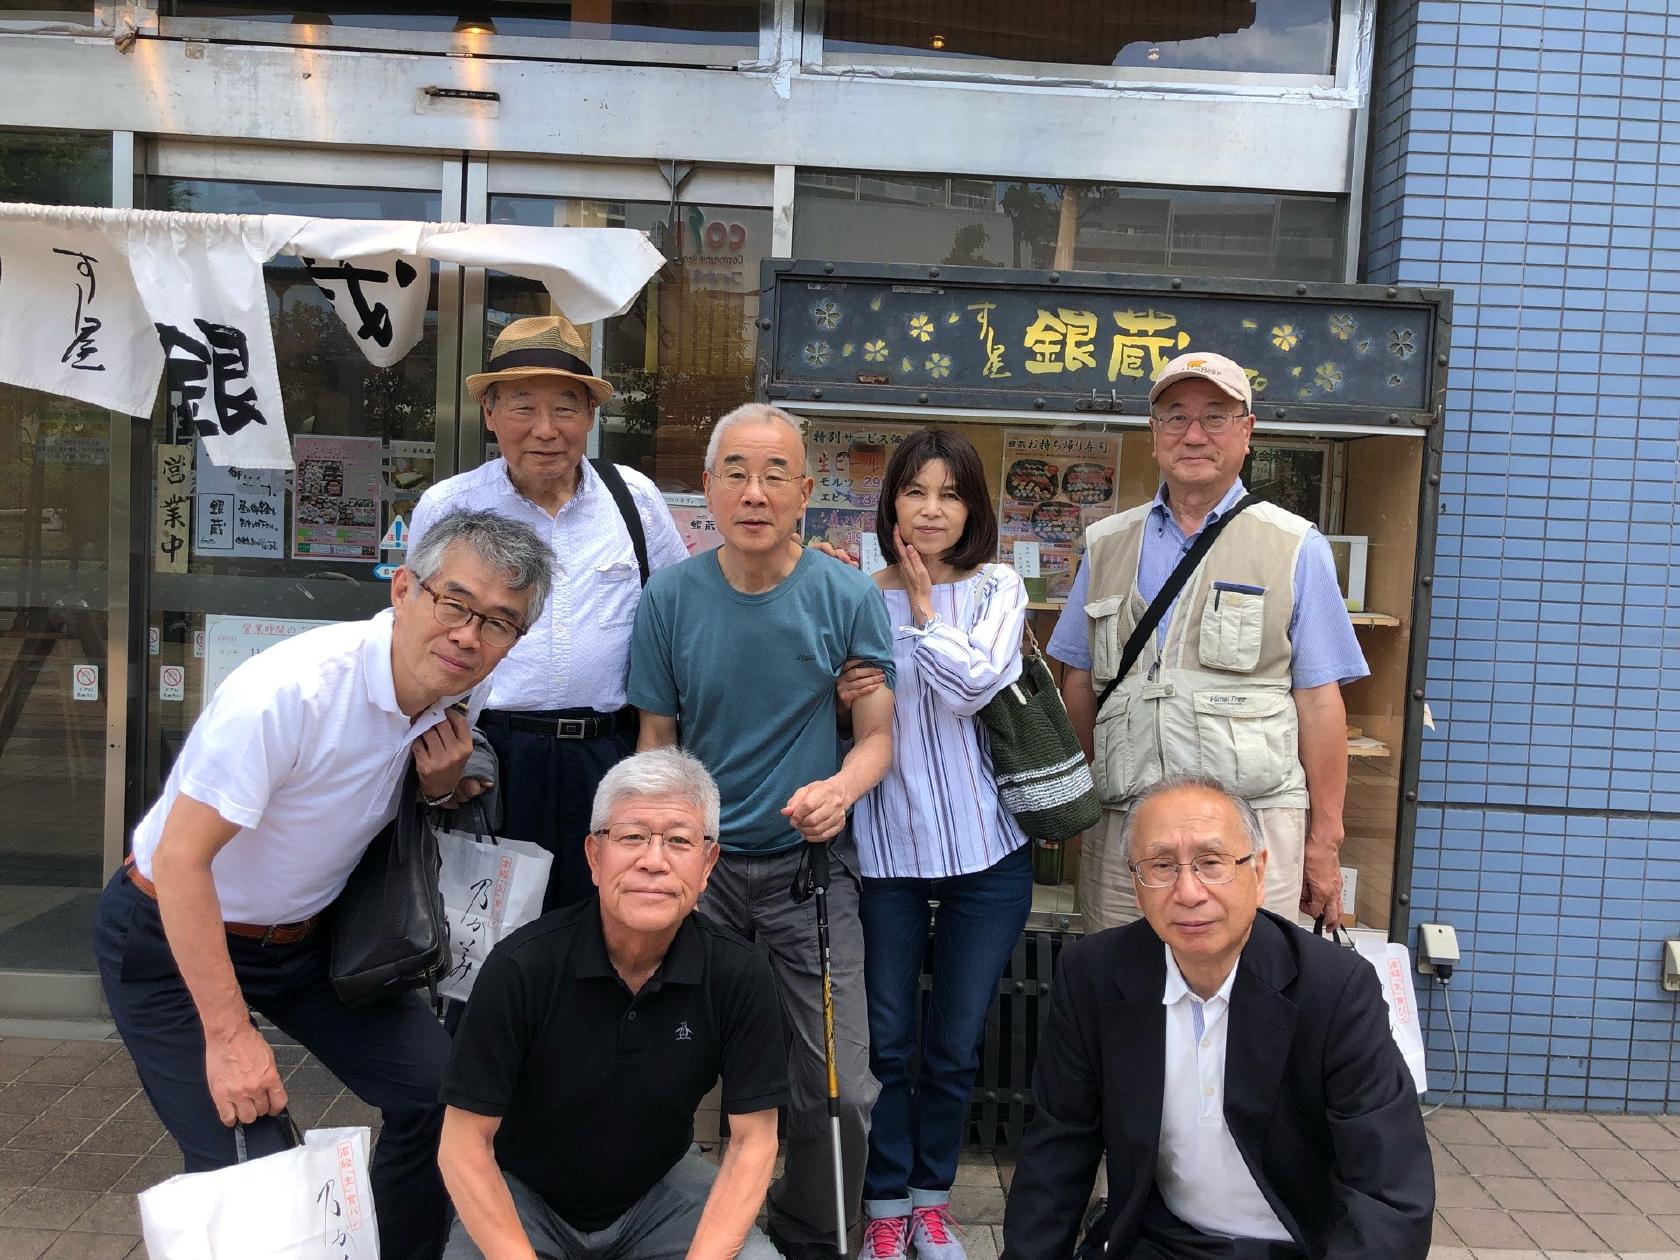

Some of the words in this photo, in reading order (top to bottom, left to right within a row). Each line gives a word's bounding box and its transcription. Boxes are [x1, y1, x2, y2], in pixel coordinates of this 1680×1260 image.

[1023, 307, 1191, 382] 銀蔵
[813, 430, 910, 444] 特別サービス価
[162, 454, 187, 563] 営業中
[863, 476, 882, 488] 29
[316, 1179, 358, 1260] 乃が
